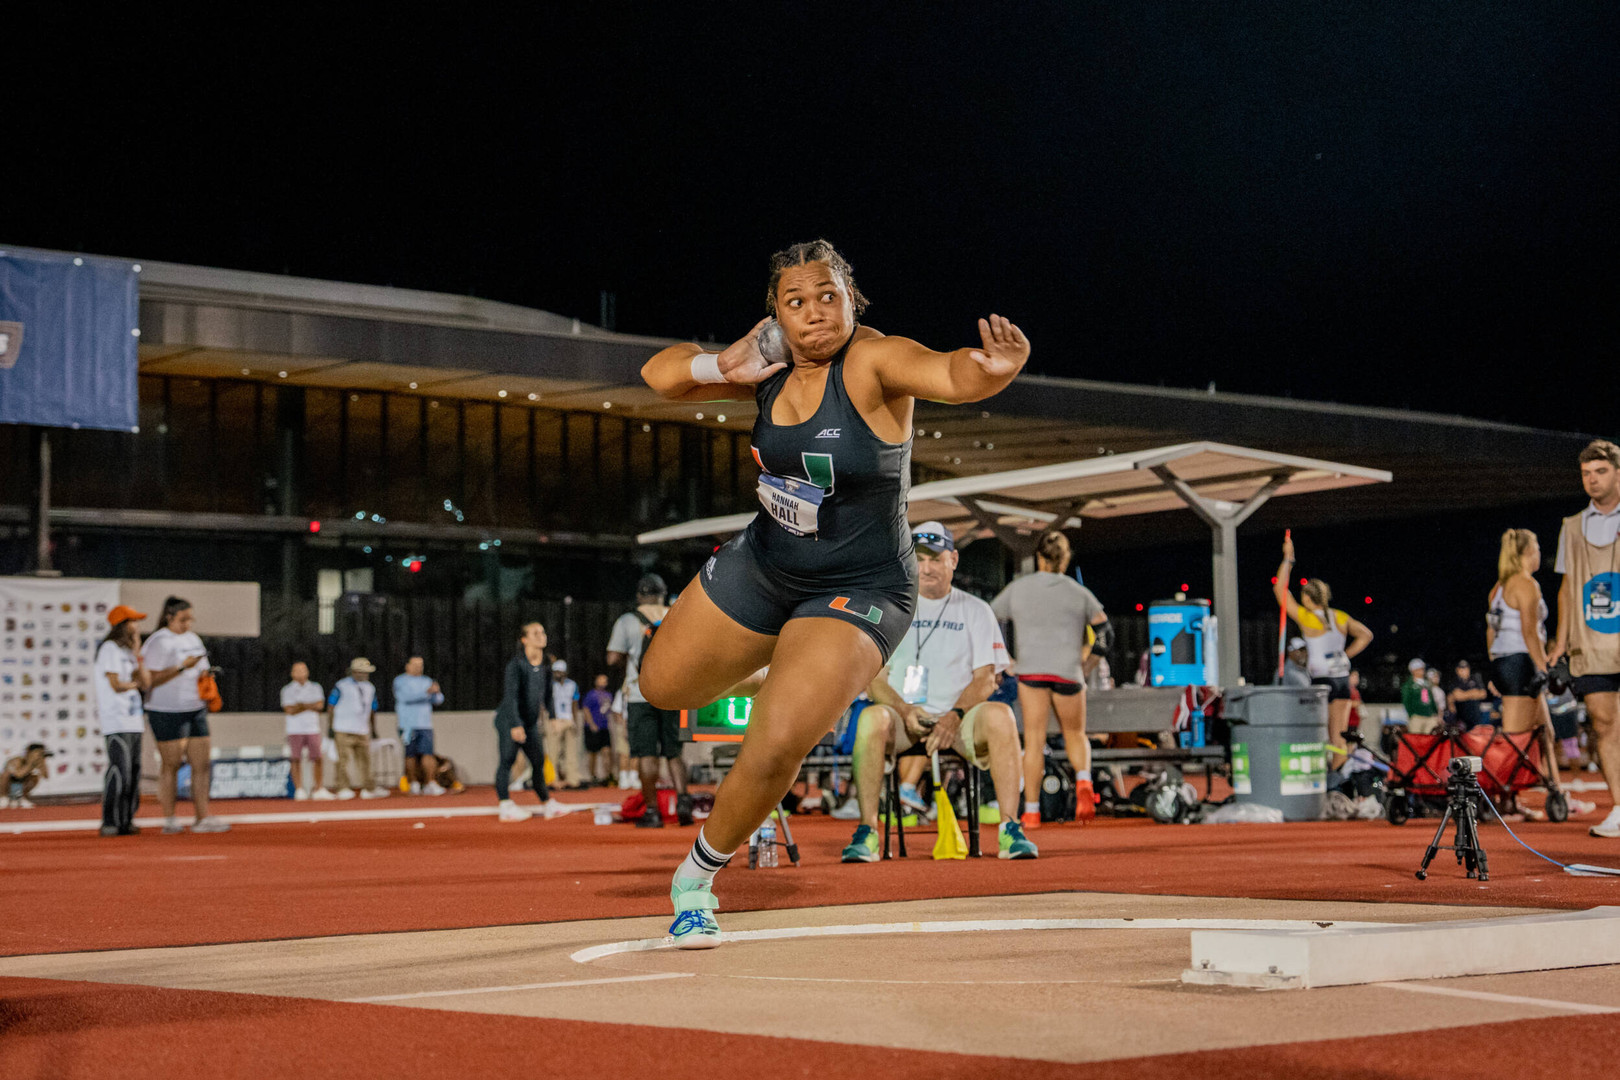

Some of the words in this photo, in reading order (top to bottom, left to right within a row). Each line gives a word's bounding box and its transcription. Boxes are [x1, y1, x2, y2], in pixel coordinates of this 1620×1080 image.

[815, 428, 841, 438] ACC
[772, 492, 799, 511] HANNAH
[771, 503, 799, 526] HALL
[943, 620, 964, 631] FIELD
